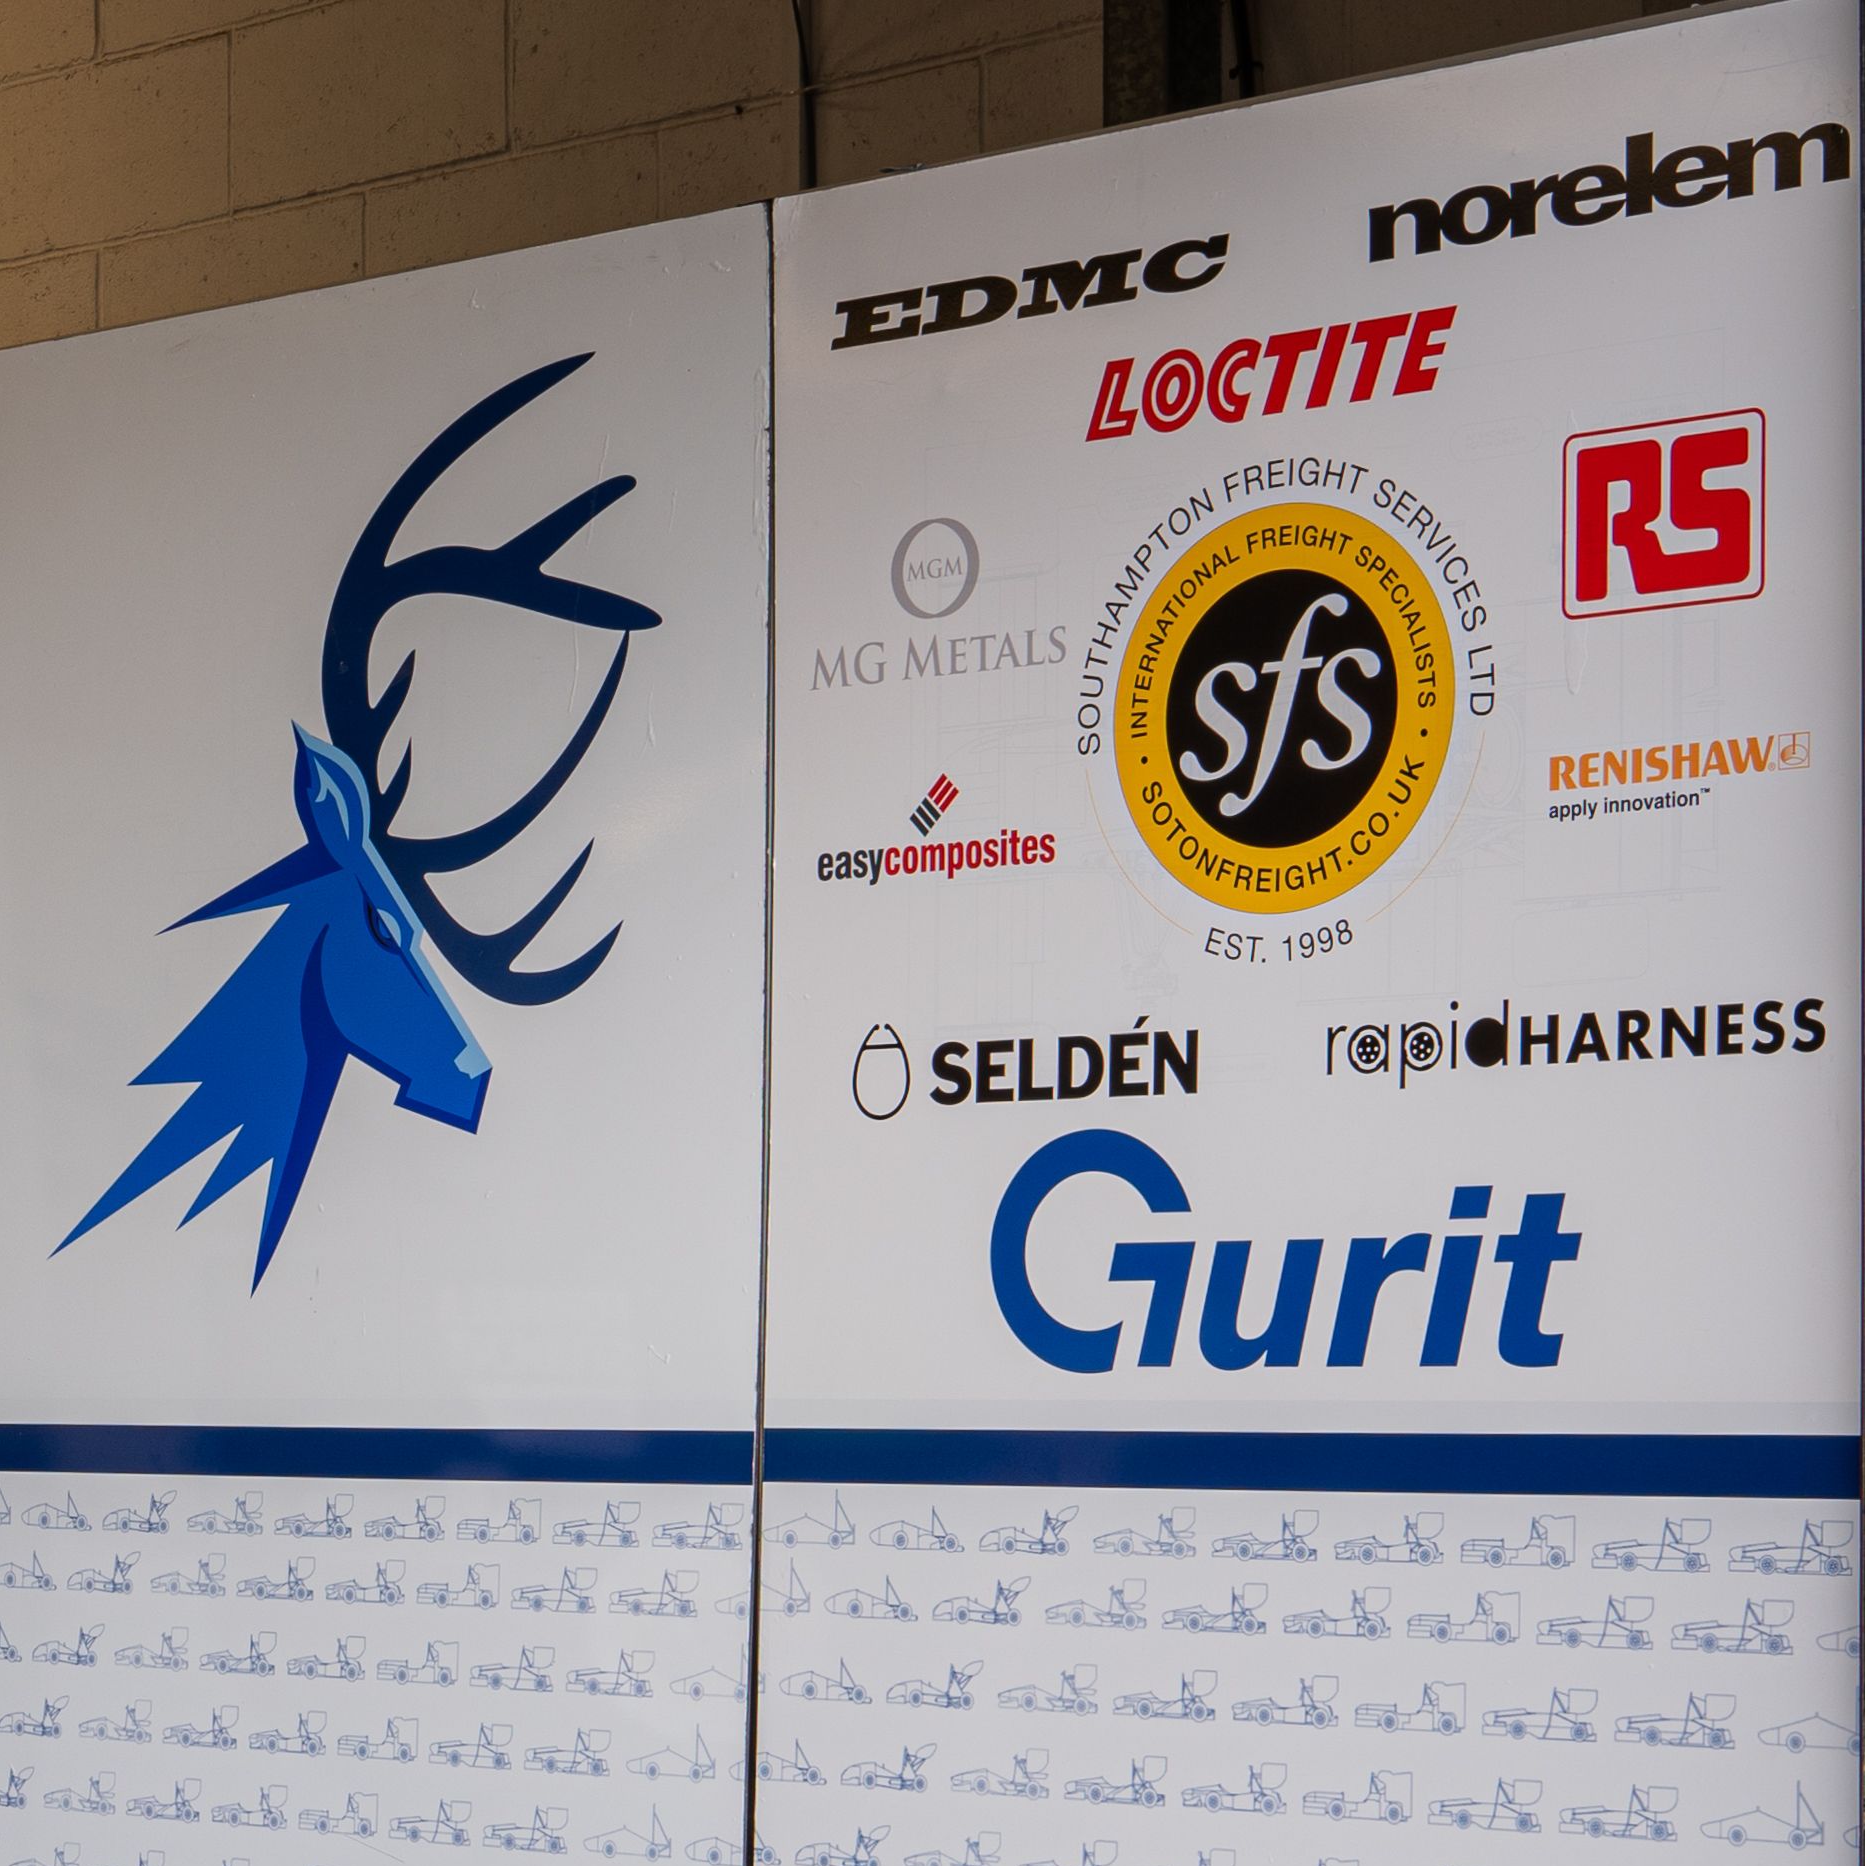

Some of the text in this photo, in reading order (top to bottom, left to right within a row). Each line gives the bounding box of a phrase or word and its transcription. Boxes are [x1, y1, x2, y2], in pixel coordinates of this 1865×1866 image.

[1369, 122, 1850, 263] norelem
[830, 233, 1230, 351] EDMC
[1085, 305, 1458, 442] LOCTITE
[907, 556, 964, 582] MGM
[1577, 427, 1752, 602] RS
[811, 625, 1067, 691] MG METALS
[1077, 457, 1495, 756] SOUTHAMPTON FREIGHT SERVICES LTD
[1131, 525, 1436, 738] INTERNATIONAL FREIGHT SPECIALISTS
[1180, 593, 1381, 817] sfs
[817, 826, 1055, 885] easycomposites
[1141, 754, 1425, 893] SOTONFREIGHT.CO.UK
[1549, 800, 1597, 822] apply
[1204, 918, 1353, 964] EST. 1998
[930, 1015, 1199, 1106] SELDÉN
[990, 1127, 1582, 1374] Gurit
